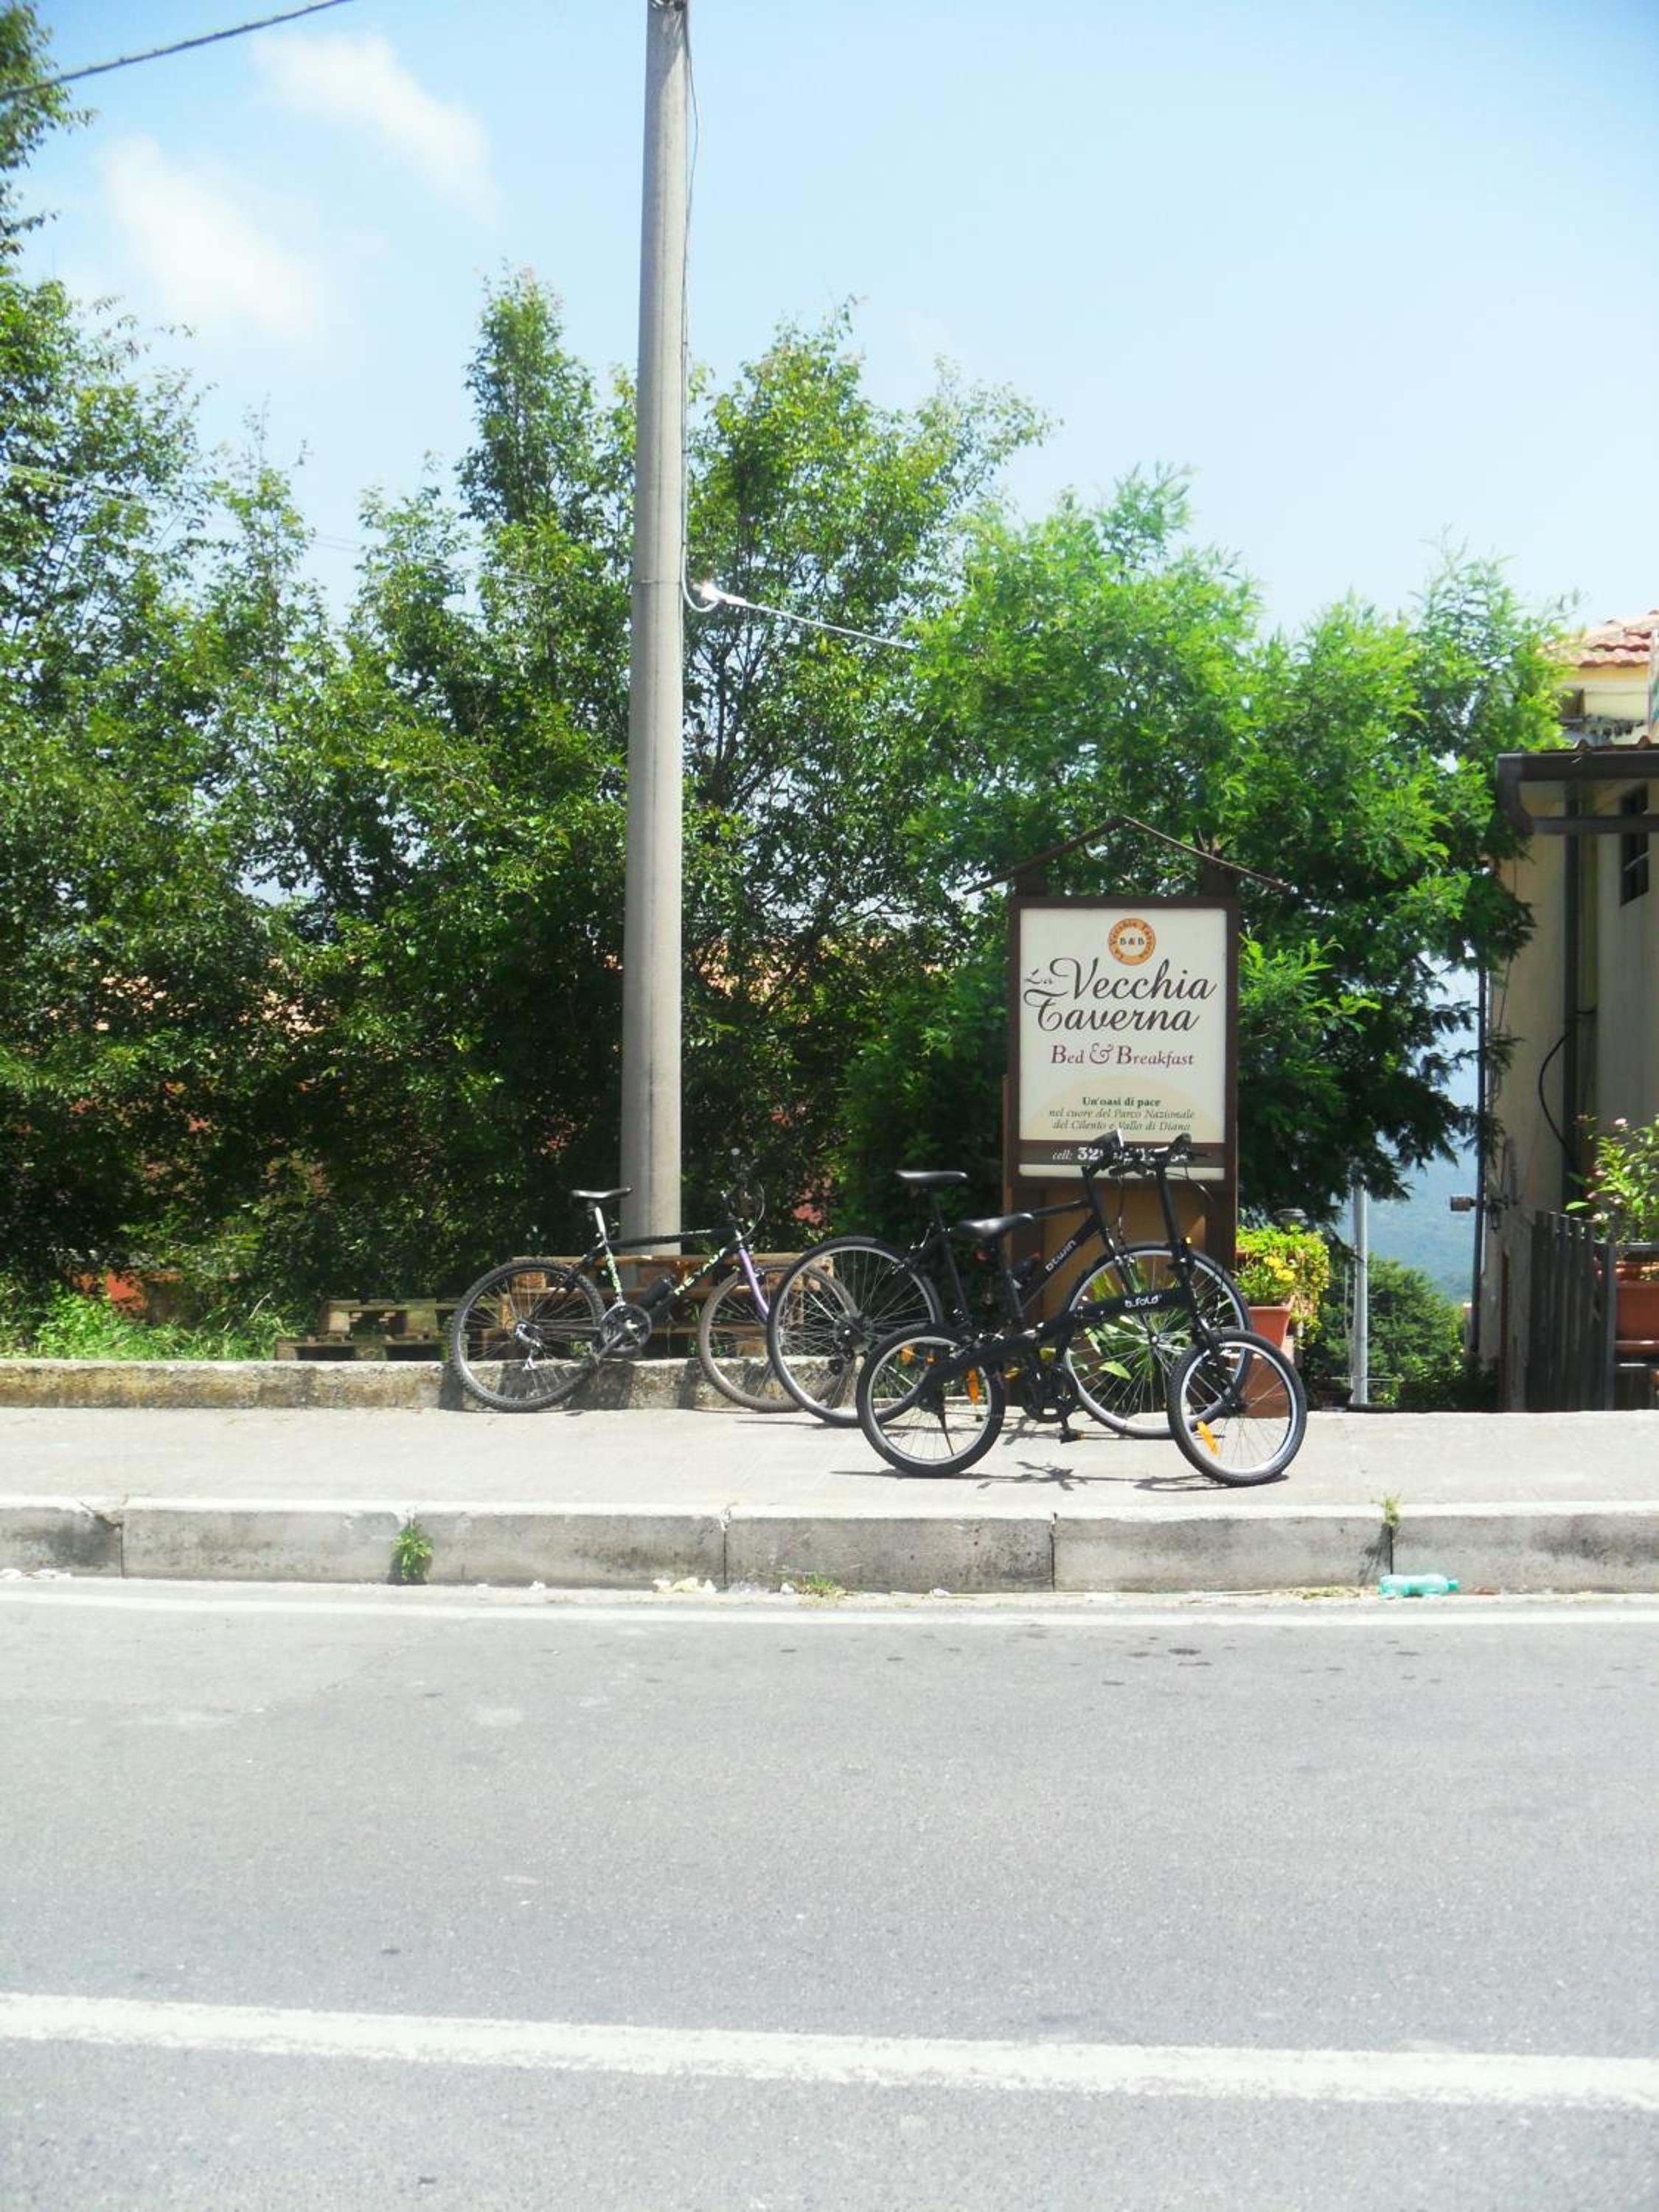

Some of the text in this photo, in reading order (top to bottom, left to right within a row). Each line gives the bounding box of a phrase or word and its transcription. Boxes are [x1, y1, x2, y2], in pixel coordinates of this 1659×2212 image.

[1023, 957, 1217, 1000] La Vecchia
[1023, 989, 1200, 1032] Taverna
[1051, 1042, 1194, 1068] Bed & Breakfast
[1082, 1096, 1161, 1109] Un'oasi di pace
[1049, 1107, 1194, 1119] nel cuore del Parco Nazionale
[1052, 1119, 1068, 1130] del
[1071, 1120, 1107, 1130] Cilento
[1118, 1121, 1143, 1131] Vallo
[1145, 1120, 1156, 1131] di
[1159, 1121, 1191, 1132] Diana
[1052, 1149, 1074, 1161] cell:
